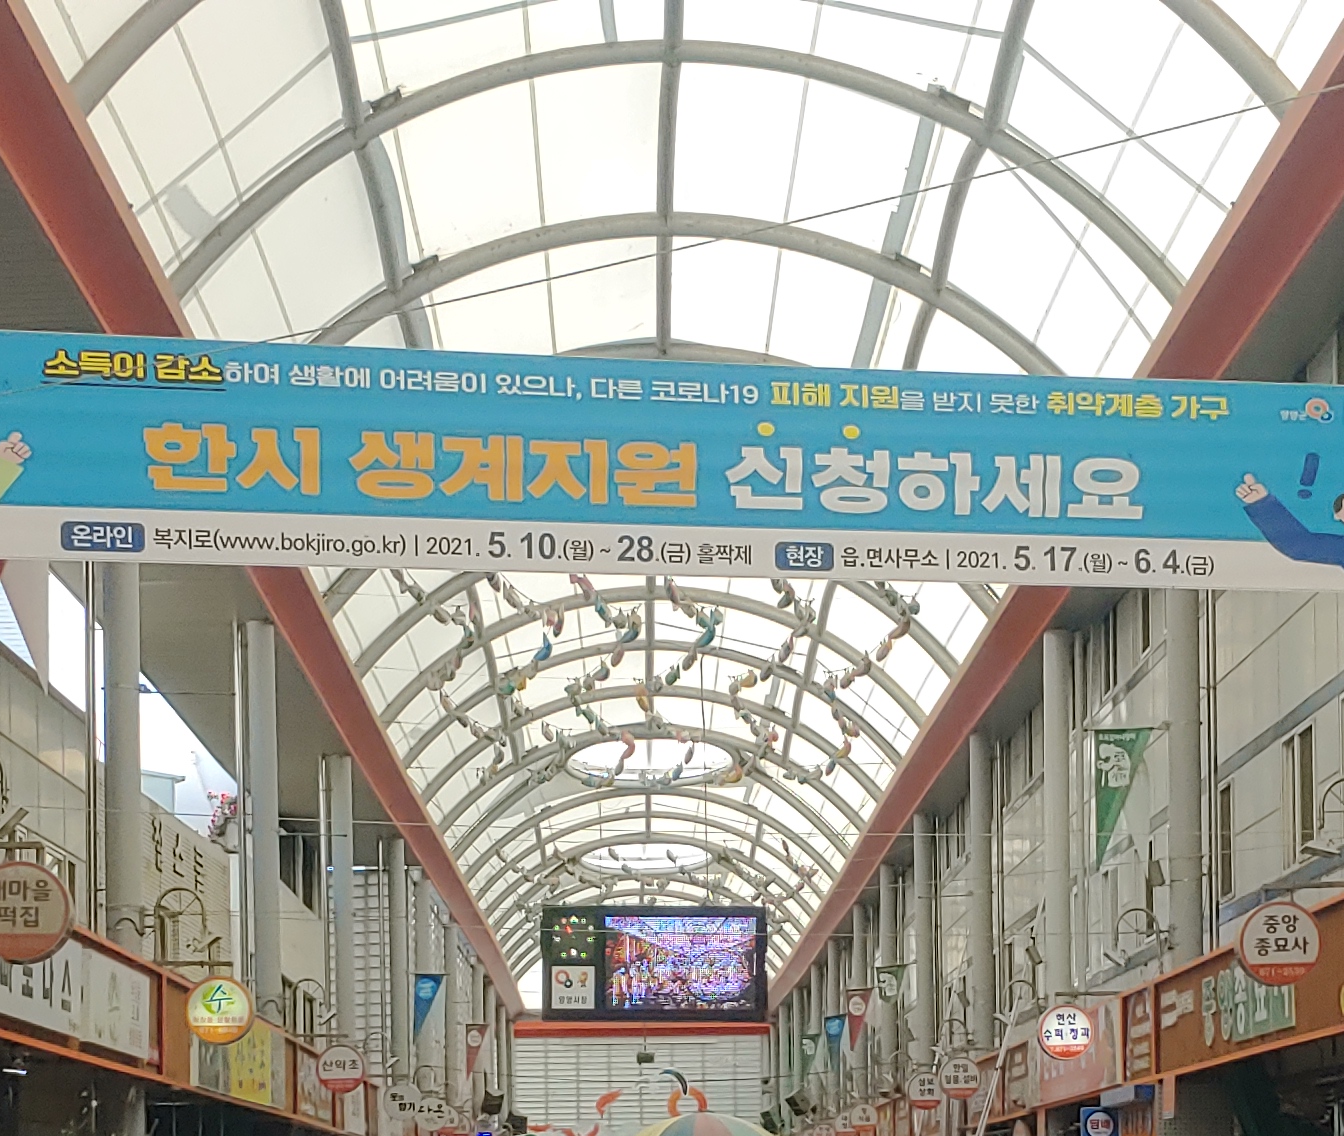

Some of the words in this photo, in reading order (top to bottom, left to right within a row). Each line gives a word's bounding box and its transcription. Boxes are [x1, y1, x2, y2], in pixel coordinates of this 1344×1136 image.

[43, 349, 145, 379] 소득이
[289, 363, 371, 391] 생활에
[379, 367, 487, 395] 어려움이
[495, 373, 582, 400] 있으나,
[590, 377, 644, 402] 다른
[650, 381, 759, 405] 코로나19
[770, 381, 831, 409] 피해
[839, 384, 925, 412] 지원을
[932, 390, 983, 415] 받지
[989, 392, 1040, 417] 못한
[1047, 392, 1164, 419] 취약계층
[1171, 394, 1230, 421] 가구
[142, 421, 322, 496] 한시
[348, 429, 698, 508] 생계지원
[724, 430, 1144, 521] 신청하세요
[70, 525, 134, 551] 온라인
[426, 535, 481, 558] 2021.
[696, 543, 754, 568] 홀짝제
[785, 545, 825, 568] 현장
[956, 549, 1007, 571] 2021.
[1253, 936, 1310, 957] 종묘사
[1262, 914, 1300, 934] 중앙
